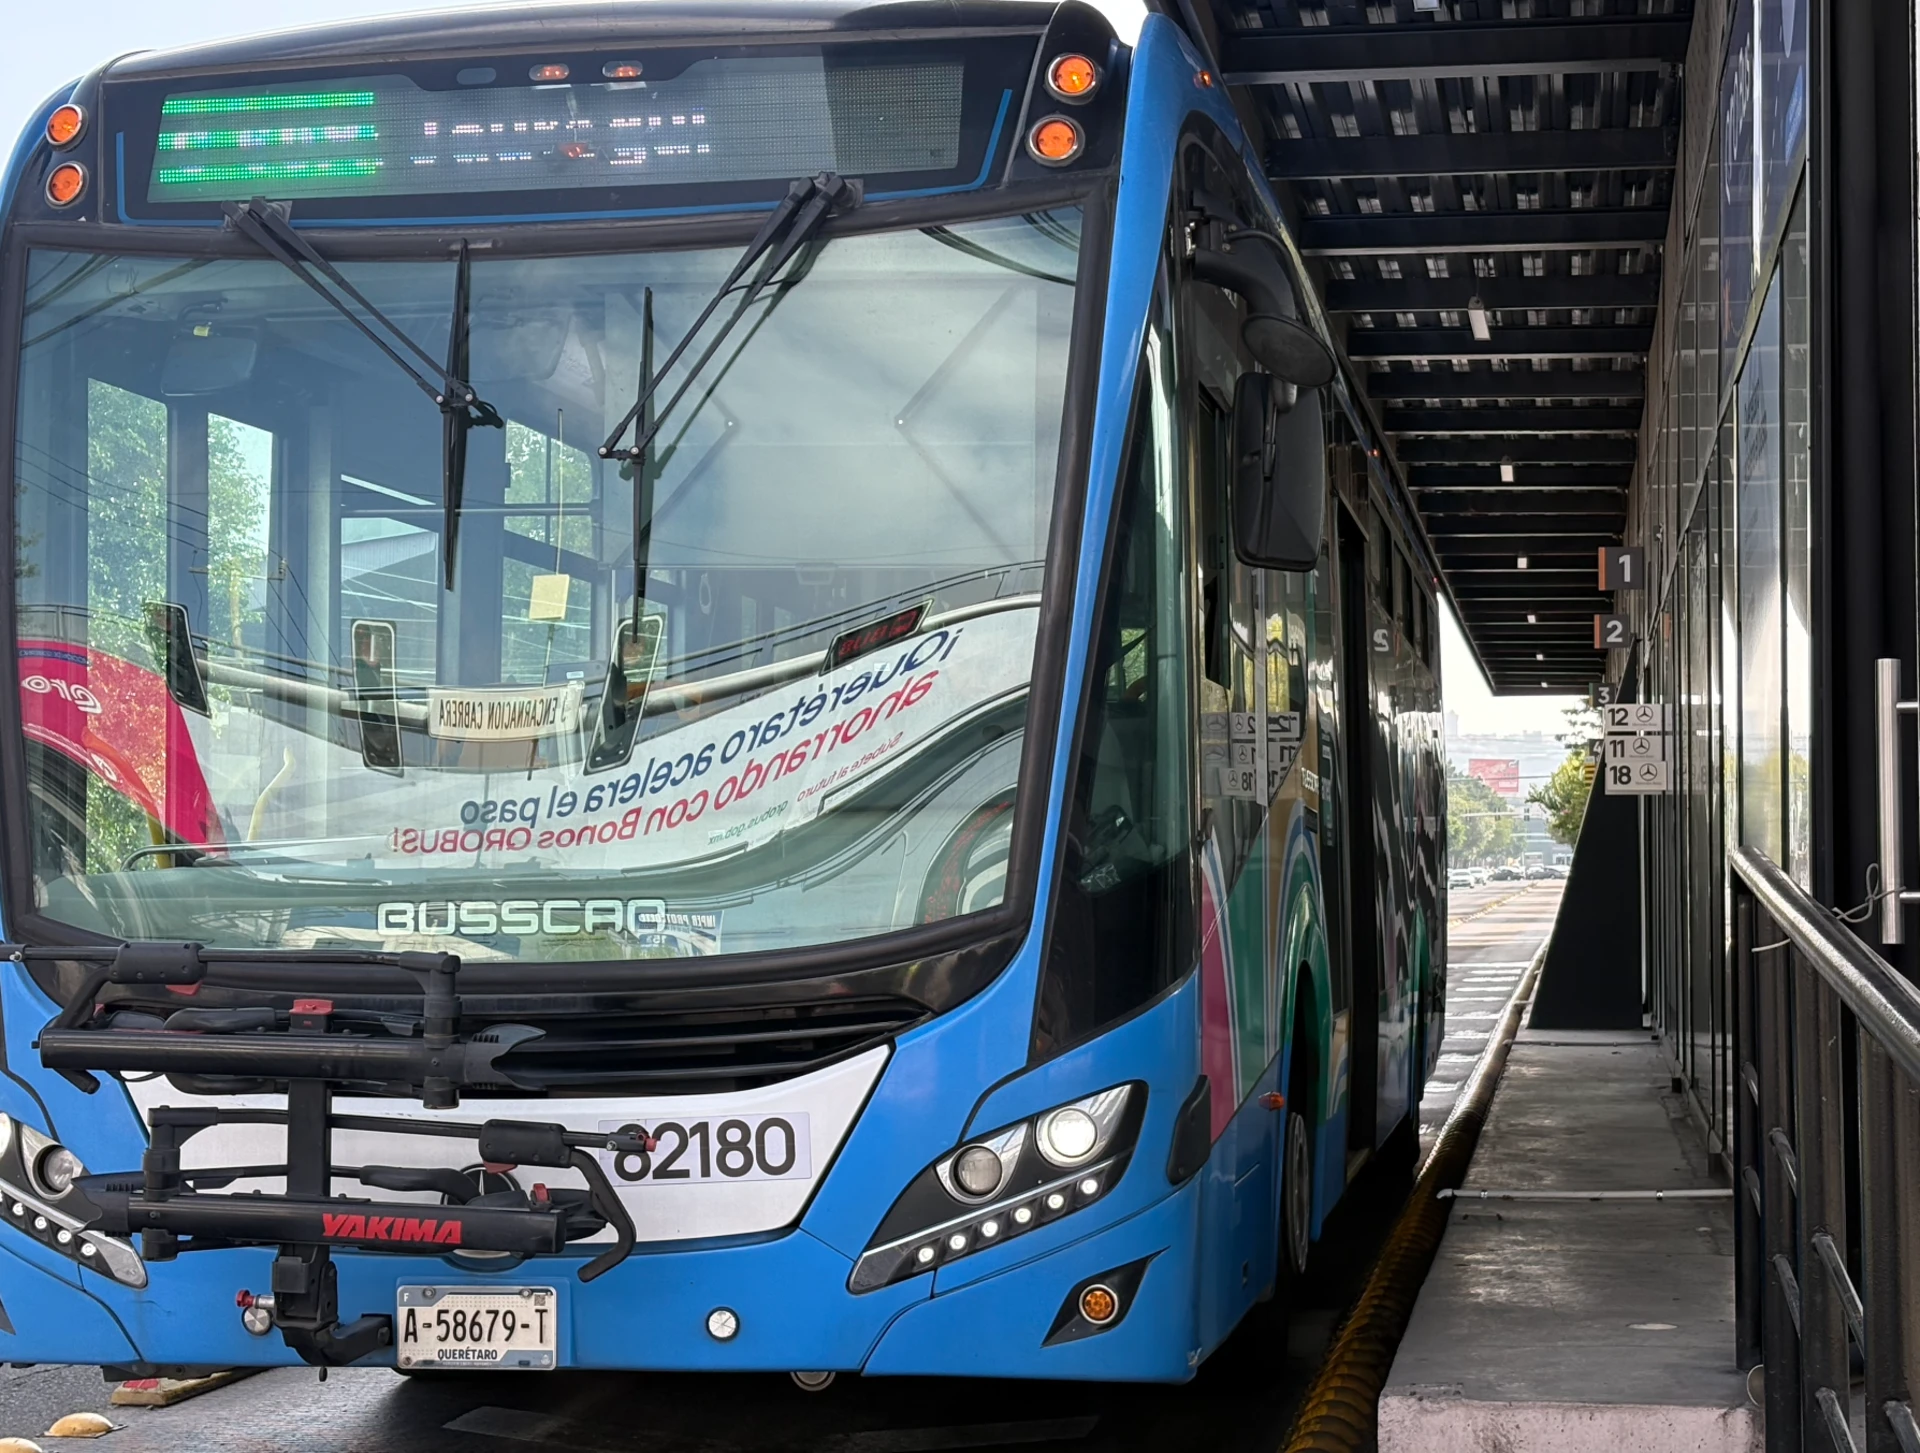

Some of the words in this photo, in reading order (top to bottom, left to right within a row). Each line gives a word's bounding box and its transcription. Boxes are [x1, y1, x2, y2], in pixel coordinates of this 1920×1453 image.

[1618, 554, 1631, 583] 1
[1606, 620, 1623, 643] 2
[1598, 687, 1610, 704] 3
[1608, 708, 1628, 726] 12
[1609, 740, 1625, 758] 11
[1609, 765, 1632, 785] 18
[378, 899, 666, 936] BUSSCAR
[614, 1117, 795, 1181] 82180
[322, 1212, 462, 1245] YAKIMA
[404, 1308, 548, 1344] A-58679-T
[437, 1347, 498, 1362] QUERÉTARO
